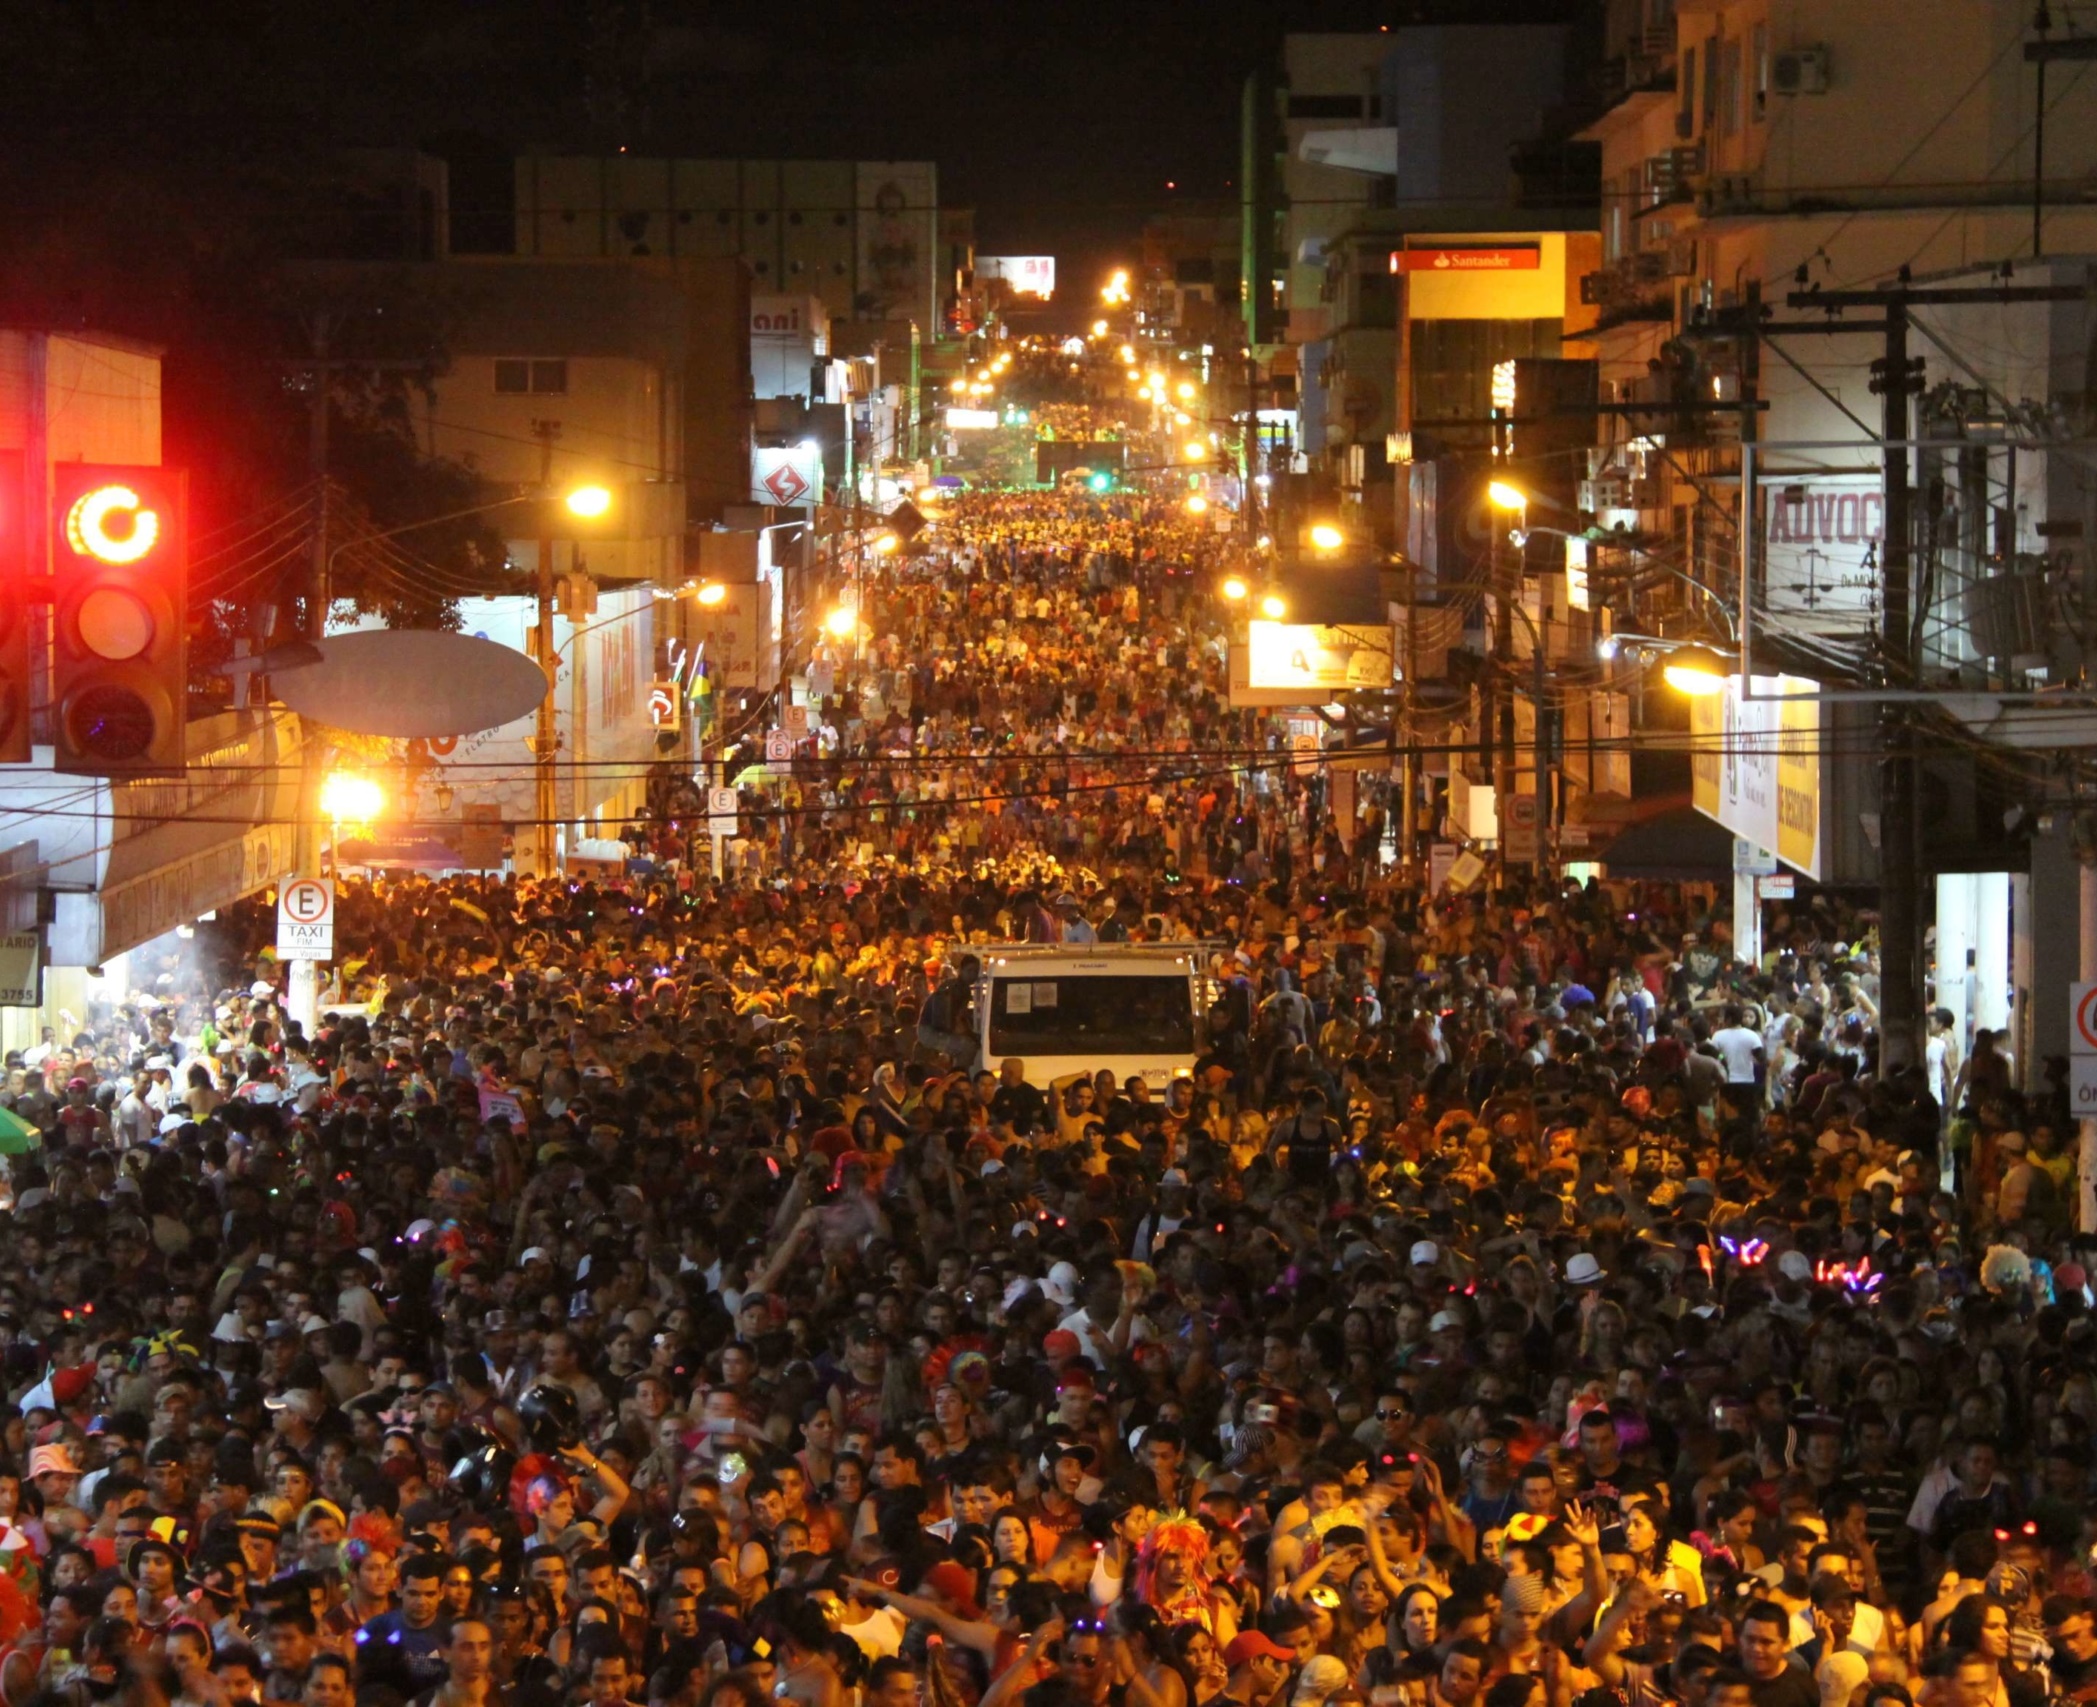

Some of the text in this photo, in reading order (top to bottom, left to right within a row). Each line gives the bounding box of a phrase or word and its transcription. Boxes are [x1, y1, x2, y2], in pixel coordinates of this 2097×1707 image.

[1452, 253, 1511, 267] Santander
[776, 743, 783, 756] E
[719, 792, 727, 807] E
[298, 888, 314, 915] E
[288, 926, 323, 938] TAXI
[296, 937, 313, 946] FIM
